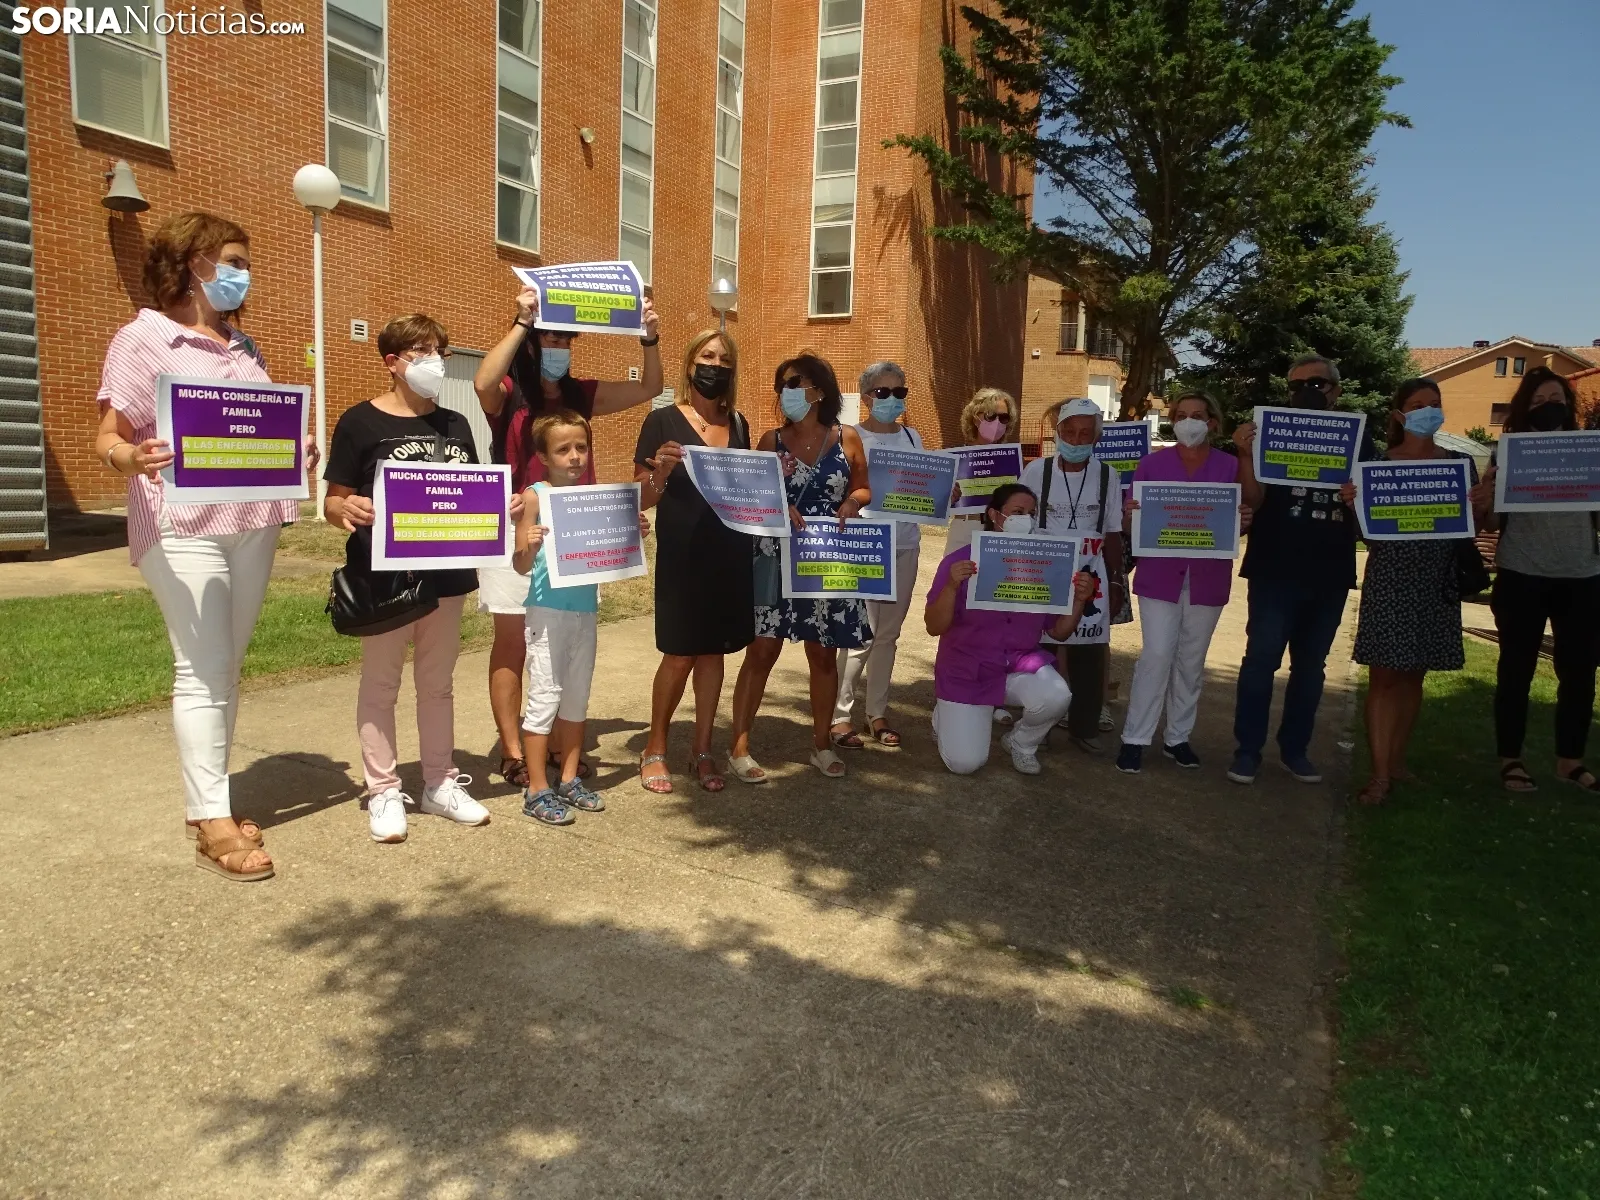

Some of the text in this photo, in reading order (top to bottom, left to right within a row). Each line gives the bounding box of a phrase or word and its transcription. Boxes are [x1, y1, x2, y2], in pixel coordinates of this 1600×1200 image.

[568, 282, 632, 292] RESIDENTES
[548, 292, 635, 307] NECESITAMOS TU
[576, 310, 610, 320] APOYO
[178, 389, 297, 404] MUCHA CONSEJERÍA DE
[223, 407, 262, 417] FAMILIA
[1271, 415, 1351, 428] UNA ENFERMERA
[230, 425, 256, 433] PERO
[1102, 428, 1142, 436] FERMERA
[1268, 428, 1293, 436] PARA
[1295, 430, 1340, 440] ATENDER
[182, 440, 190, 448] A
[193, 440, 213, 449] LAS
[217, 440, 280, 450] ENFERMERAS
[1095, 440, 1135, 448] ATENDER
[1287, 442, 1346, 454] RESIDENTES
[422, 442, 470, 462] WNGS
[969, 450, 1007, 458] CONSEJERÍA
[184, 457, 295, 465] NOS DEJAN CONCILIAR
[1266, 453, 1330, 466] NECESITAMOS
[390, 472, 423, 480] MUCHA
[426, 472, 484, 482] CONSEJERÍA
[1287, 468, 1318, 477] APOYO
[1370, 468, 1457, 478] UNA ENFERMERA
[1400, 481, 1448, 489] ATENDER
[426, 487, 463, 495] FAMILIA
[580, 493, 615, 501] NUESTROS
[1373, 494, 1457, 504] 170 RESIDENTES
[432, 502, 458, 510] PERO
[567, 506, 582, 514] SON
[584, 504, 617, 512] NUESTROS
[1371, 506, 1460, 516] NECESITAMOS TU
[1399, 521, 1434, 529] APOYO
[573, 528, 596, 537] JUNTA
[827, 538, 873, 548] ATENDER
[566, 551, 606, 560] ENFERMERA
[820, 552, 881, 562] RESIDENTES
[798, 566, 884, 576] NECESITAMOS TU
[1075, 624, 1102, 638] vido
